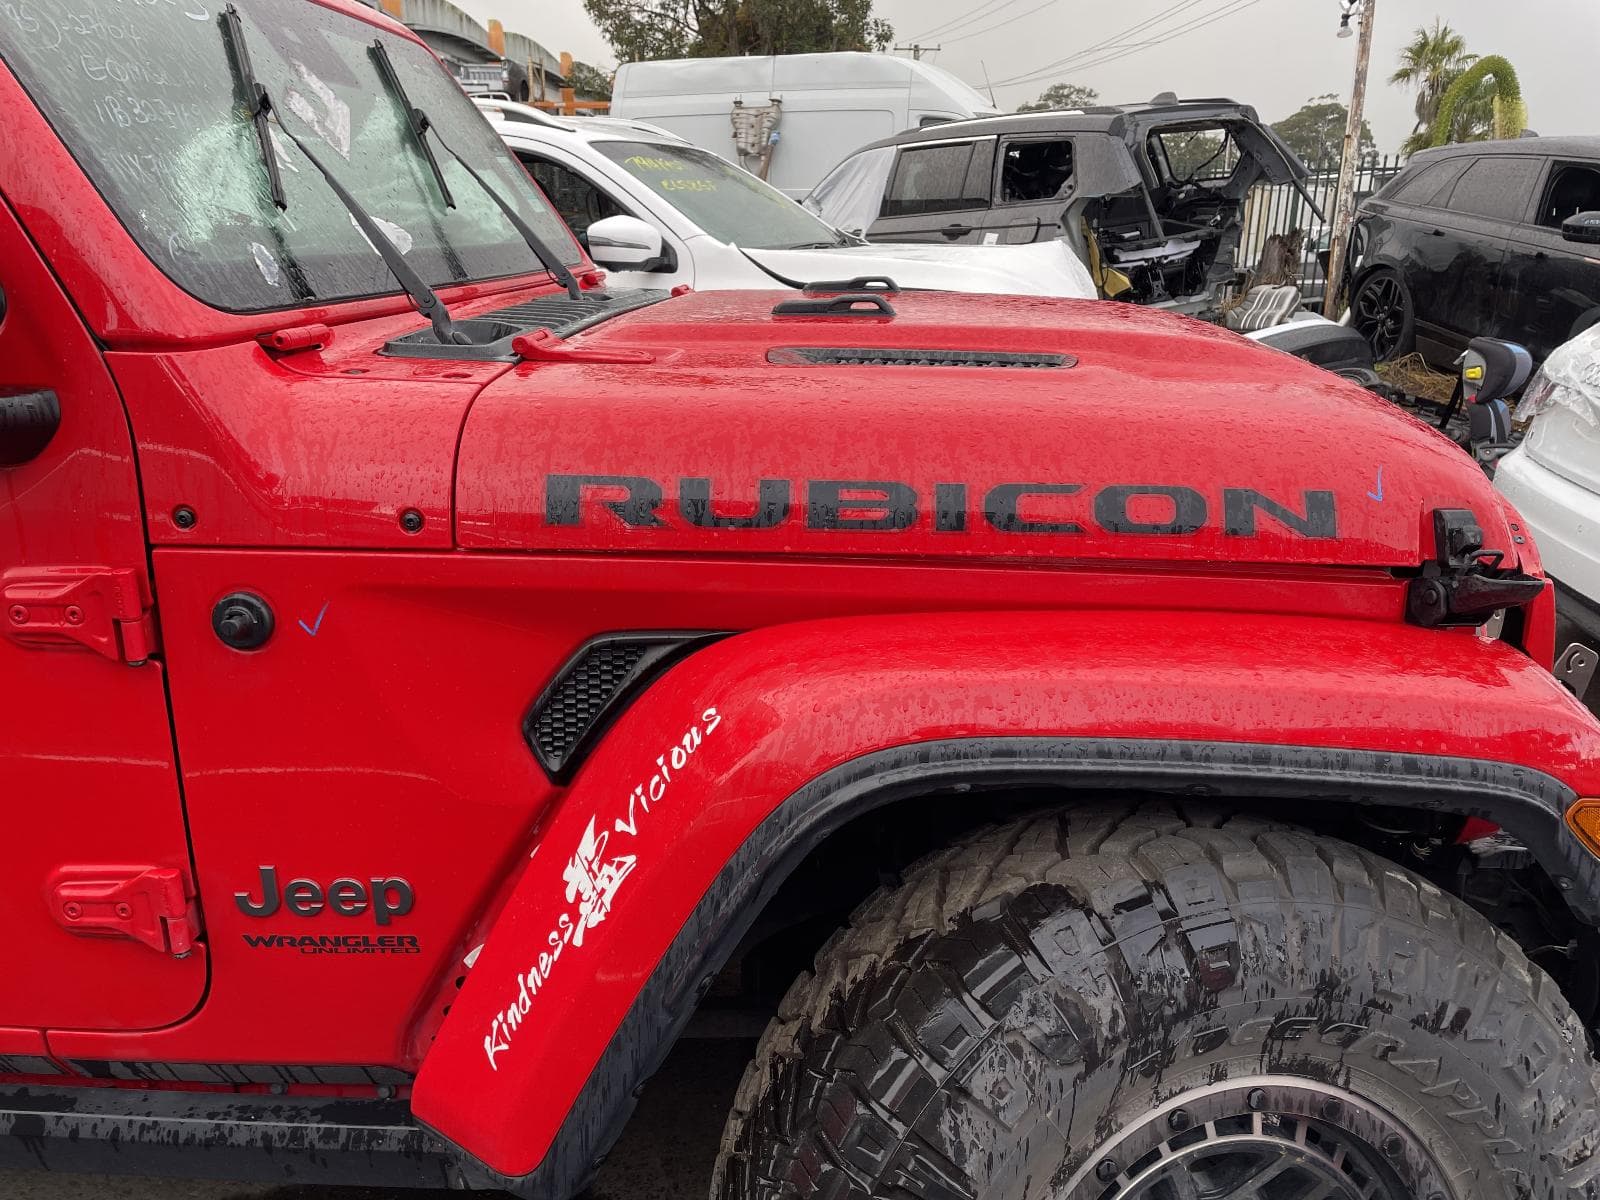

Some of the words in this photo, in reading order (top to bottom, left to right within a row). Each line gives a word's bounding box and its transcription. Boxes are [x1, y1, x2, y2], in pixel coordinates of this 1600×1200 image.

[545, 473, 1338, 540] RUBICON
[234, 865, 415, 926] Jeep
[483, 913, 574, 1072] Kindness
[615, 706, 722, 836] Vicious
[243, 934, 418, 948] WRANGLER
